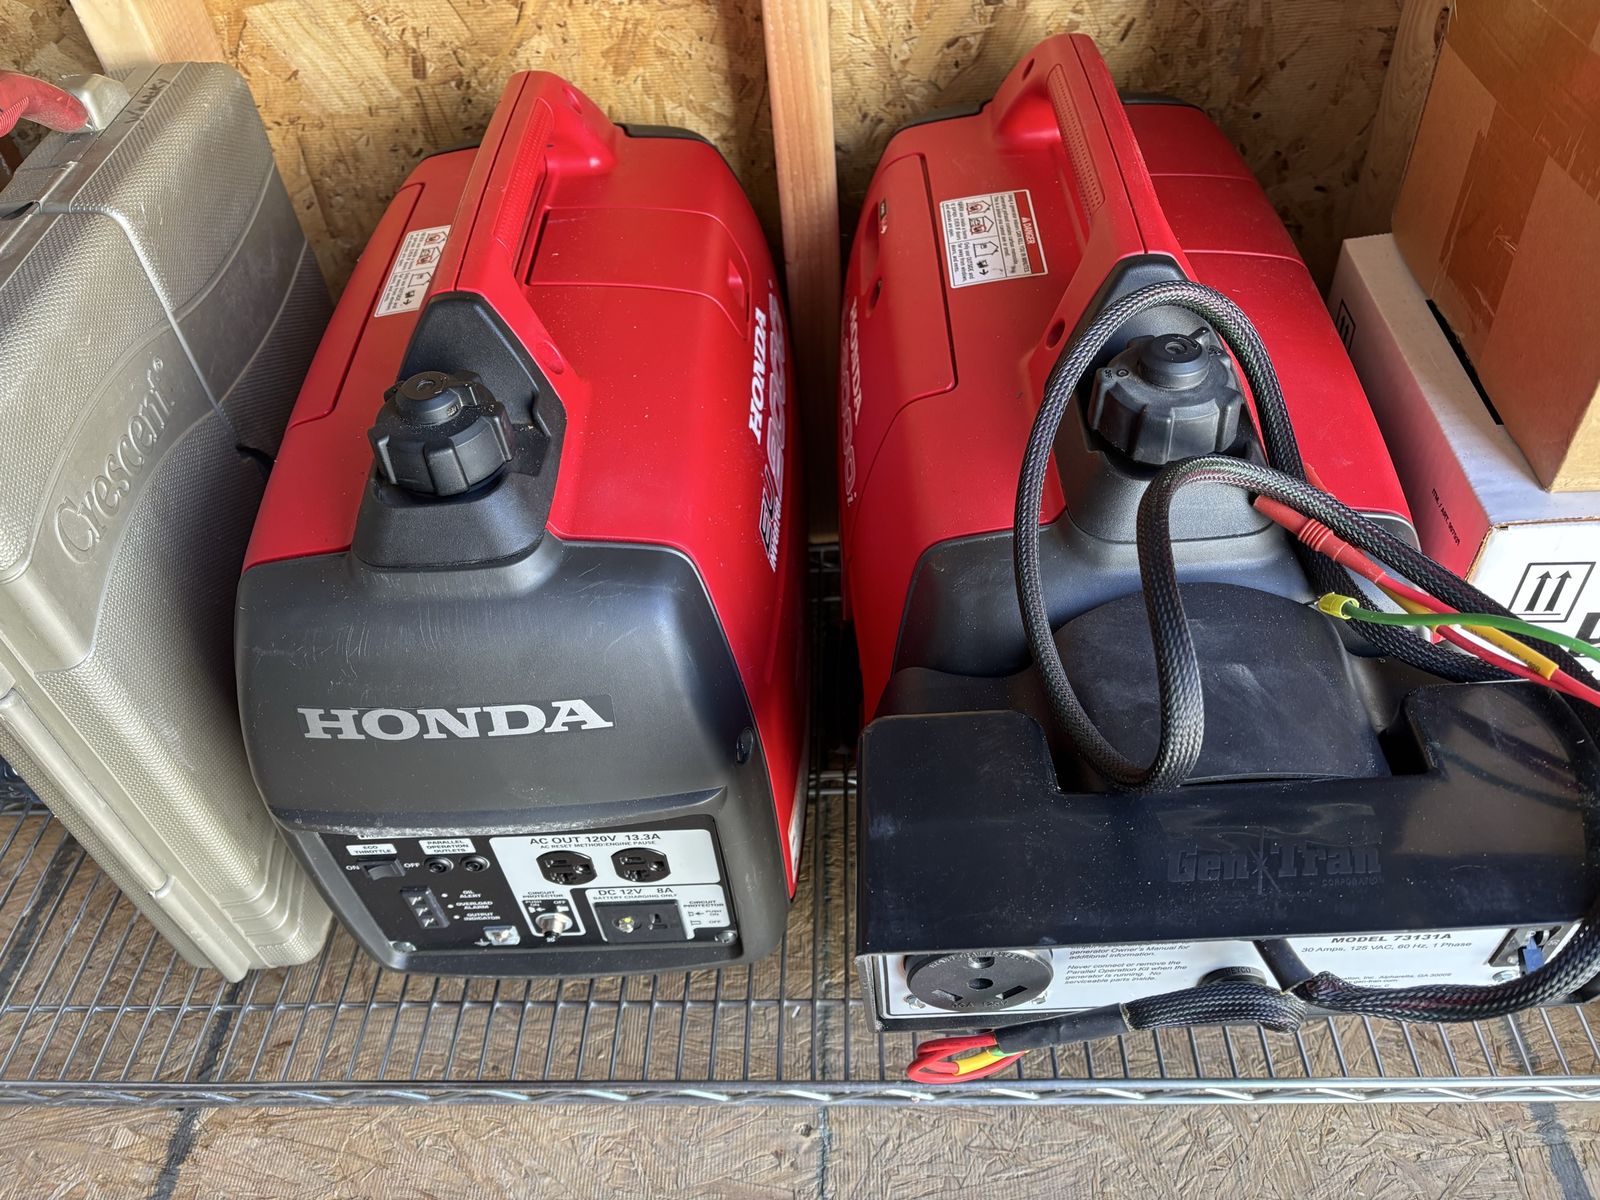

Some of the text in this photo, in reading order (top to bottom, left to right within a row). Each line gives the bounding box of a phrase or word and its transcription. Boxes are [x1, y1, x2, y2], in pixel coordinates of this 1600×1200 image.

[1022, 222, 1035, 245] DANGER
[750, 306, 767, 445] HONDA
[850, 296, 862, 426] HONDA
[297, 699, 614, 741] HONDA
[529, 837, 548, 845] AC
[585, 835, 616, 843] 120V
[625, 833, 661, 841] 13.3A
